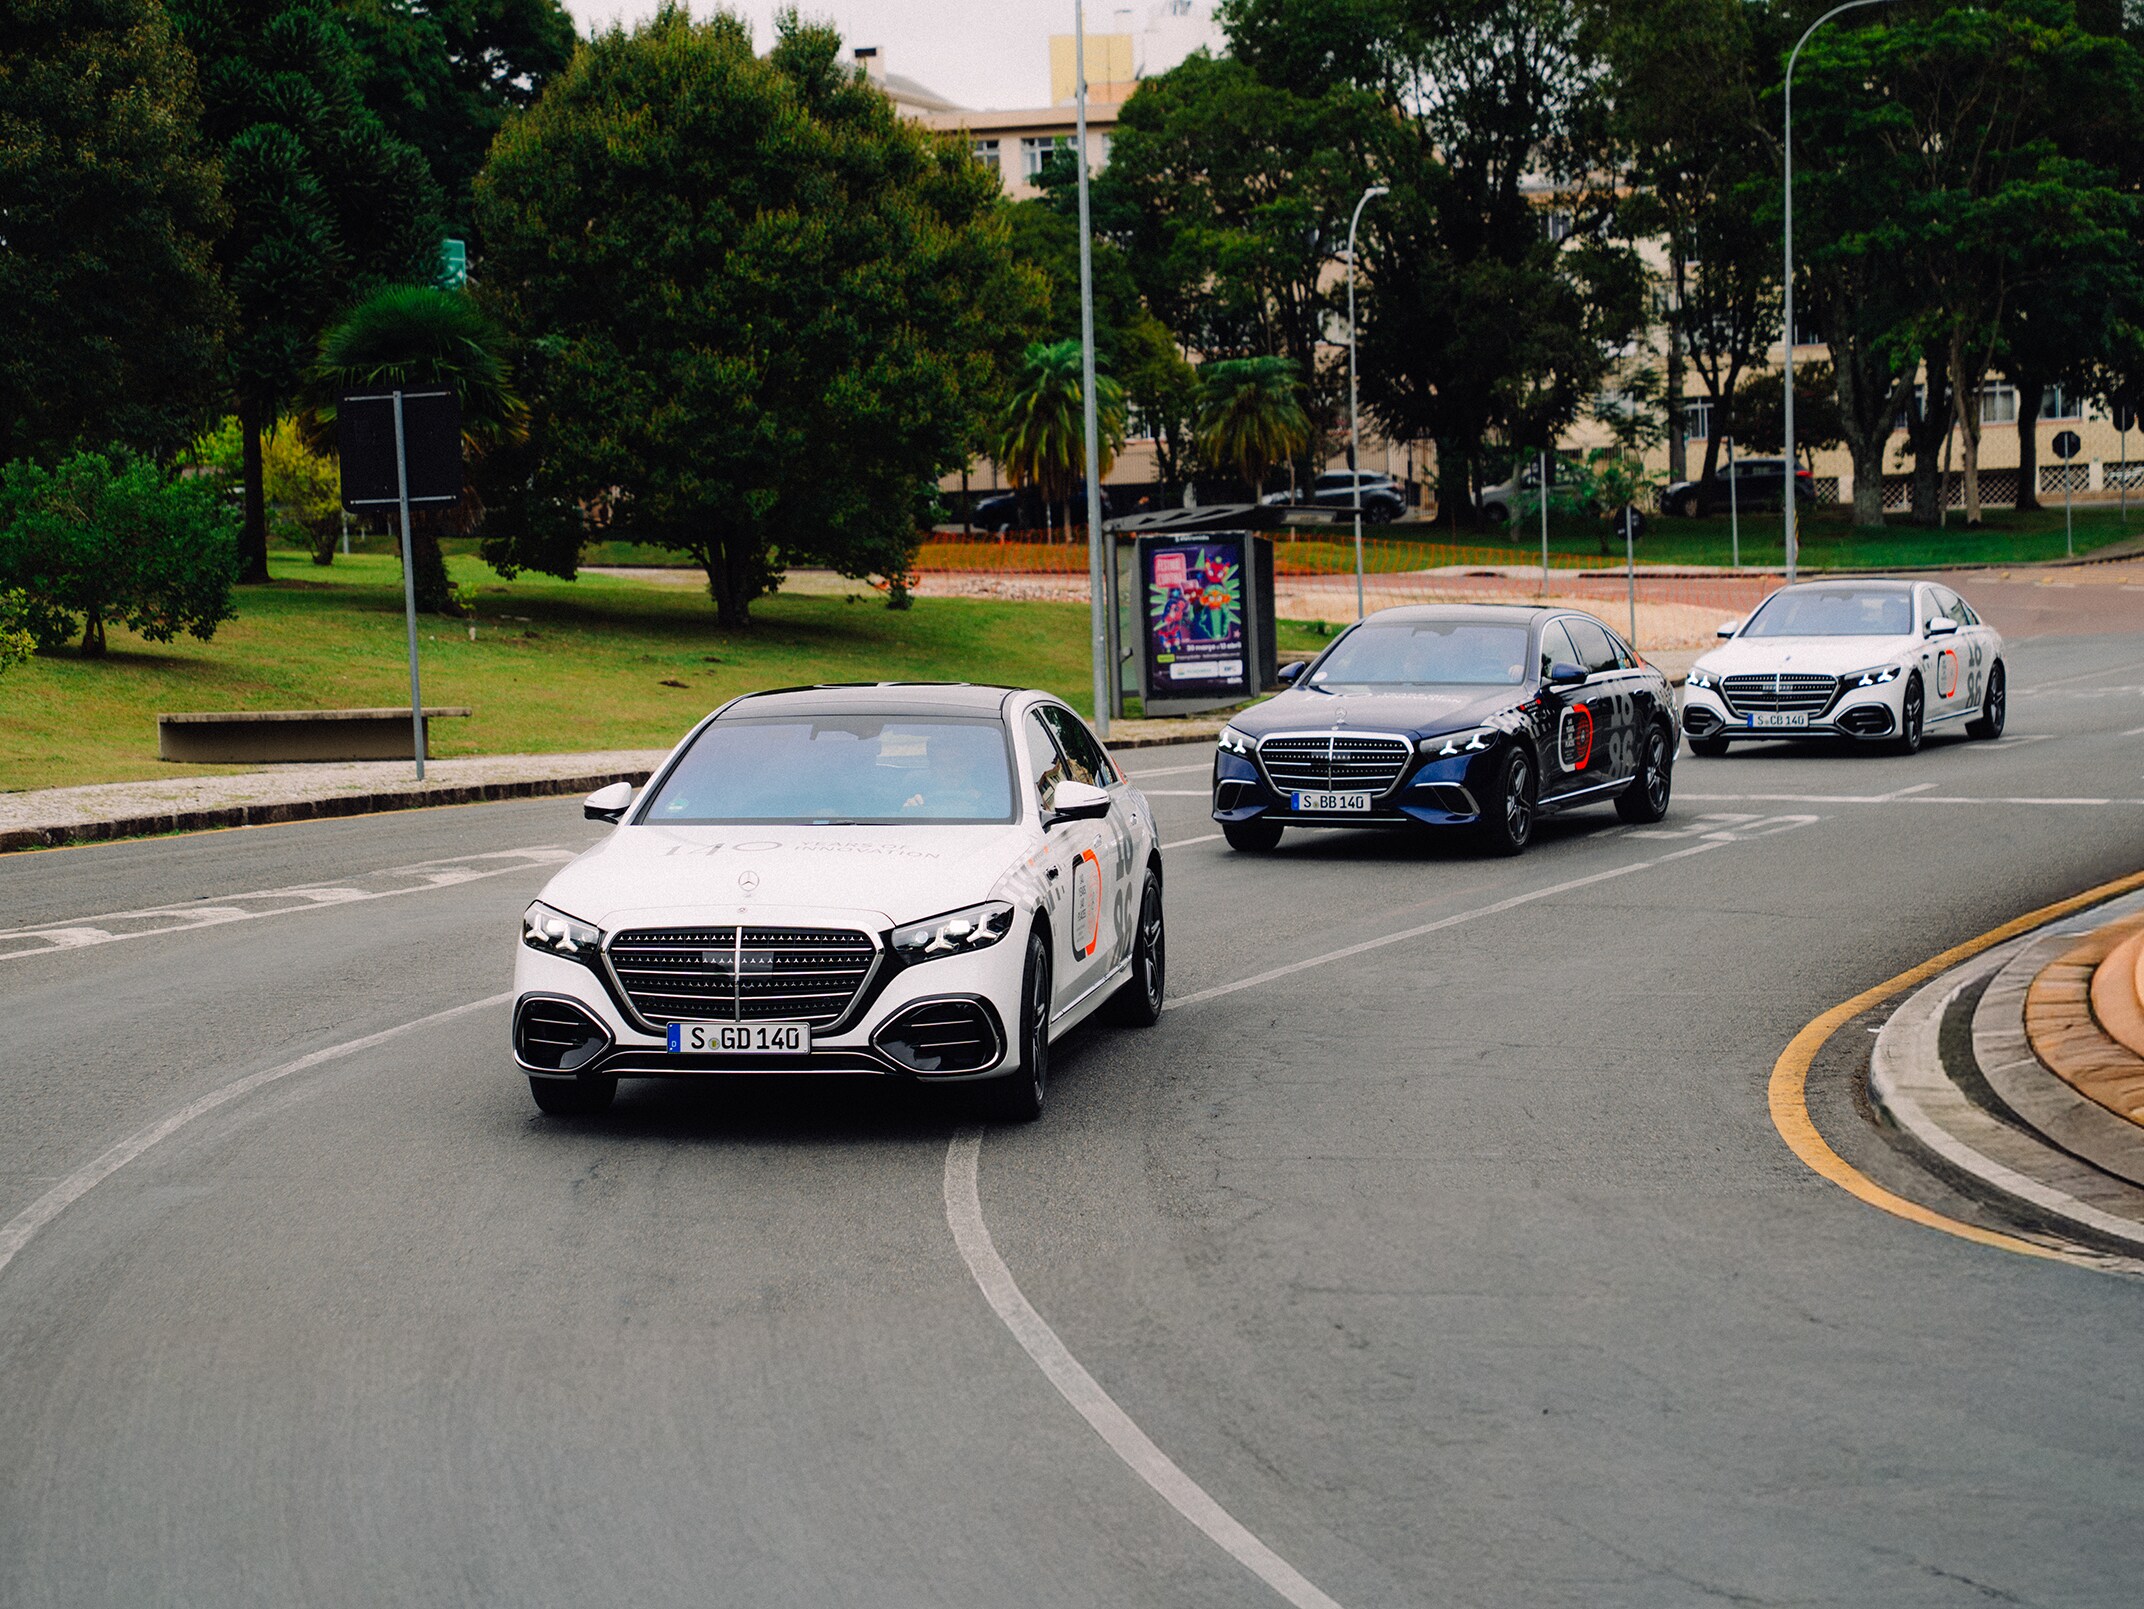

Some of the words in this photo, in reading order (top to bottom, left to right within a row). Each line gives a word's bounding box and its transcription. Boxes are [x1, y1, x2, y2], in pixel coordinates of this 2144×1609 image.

[1757, 715, 1764, 725] S
[1786, 715, 1804, 725] 140
[1303, 795, 1312, 808] S
[1320, 795, 1337, 808] BB
[1340, 795, 1364, 809] 140
[794, 845, 941, 859] INNOVATION
[691, 1027, 705, 1050] S
[721, 1027, 751, 1050] GD
[756, 1027, 800, 1050] 140
